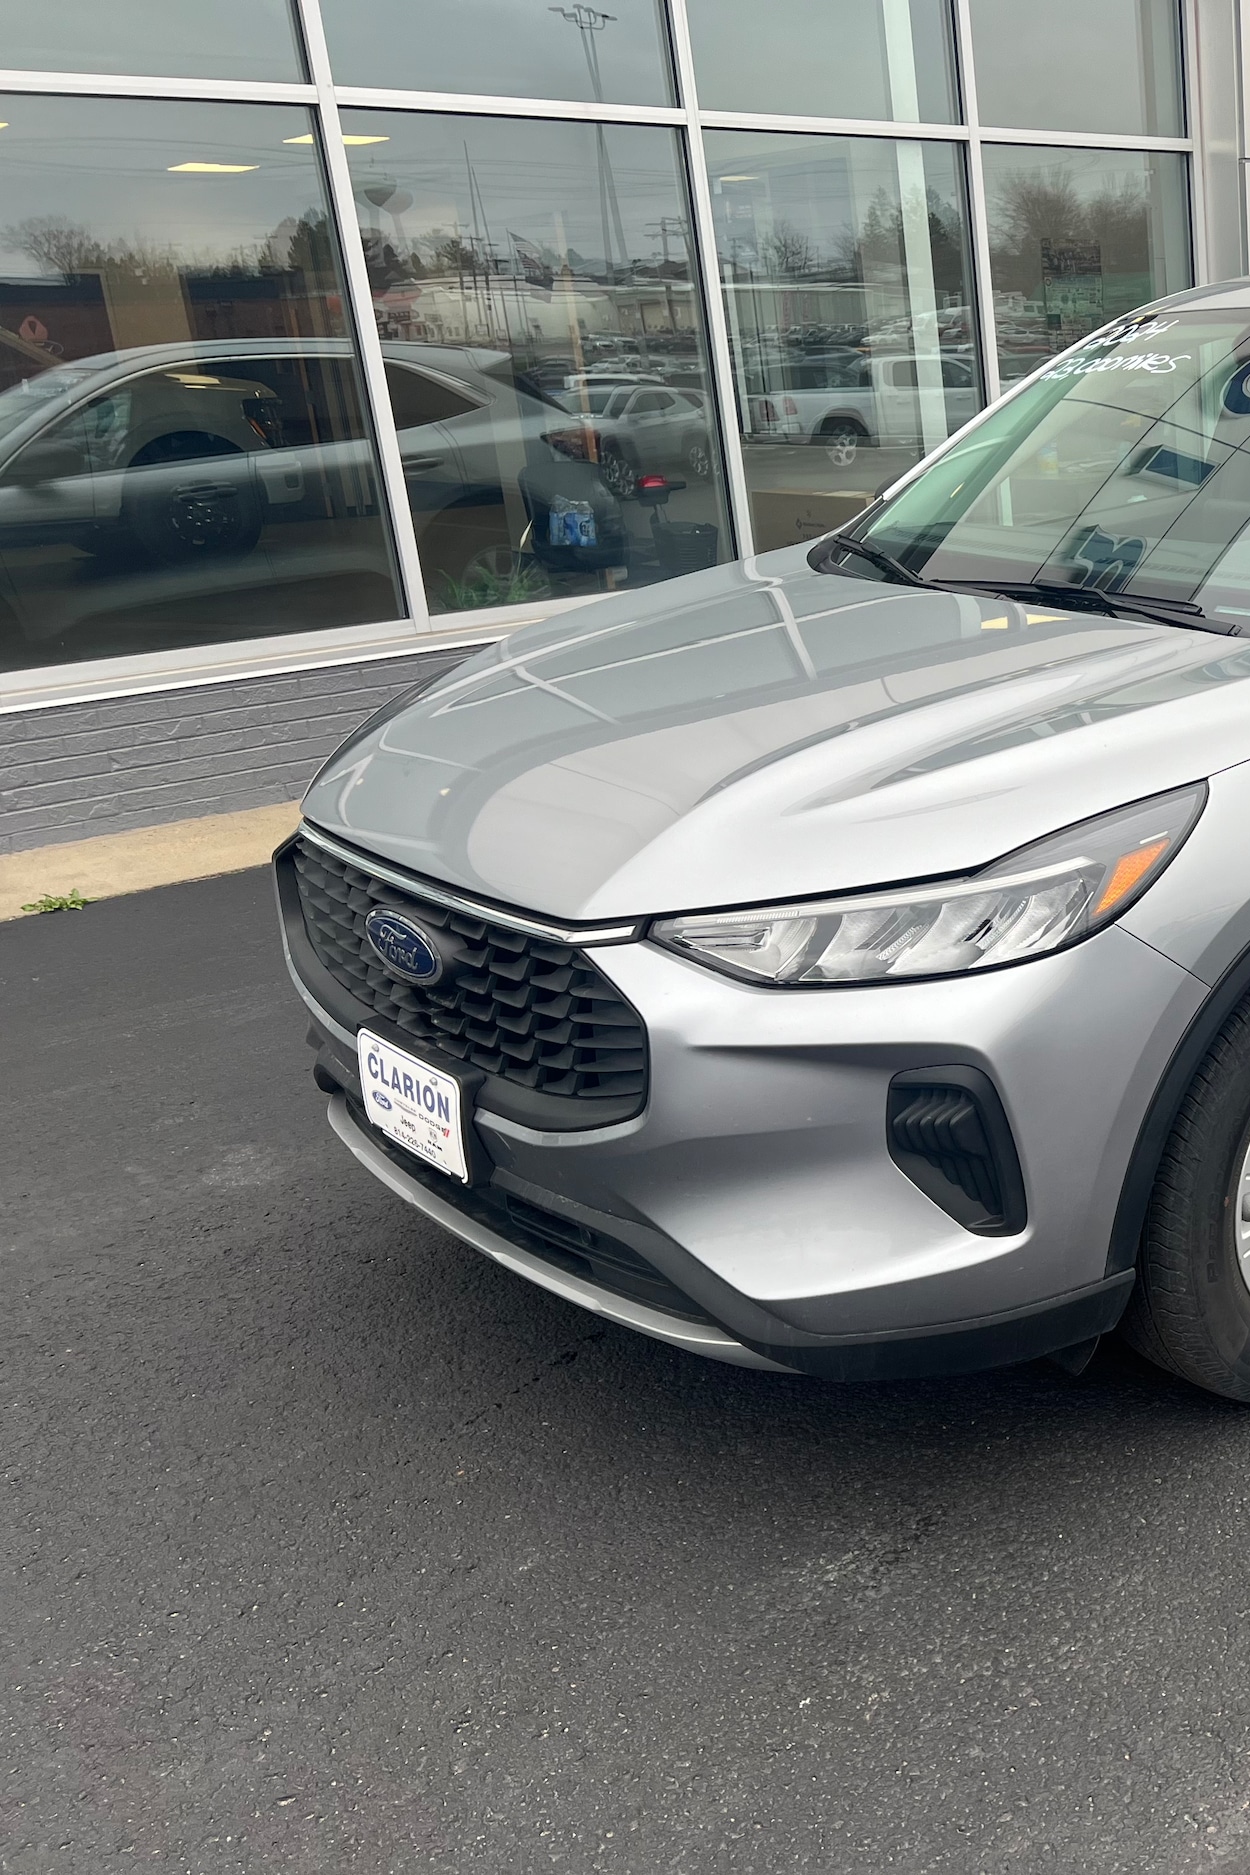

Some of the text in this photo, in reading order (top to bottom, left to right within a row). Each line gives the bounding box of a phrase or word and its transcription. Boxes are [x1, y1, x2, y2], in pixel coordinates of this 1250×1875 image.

[1083, 319, 1180, 350] 2024
[378, 924, 419, 970] Ford
[367, 1052, 451, 1123] CLARION
[375, 1091, 391, 1110] Ford
[400, 1115, 416, 1133] Jeep
[418, 1113, 446, 1133] DODGE
